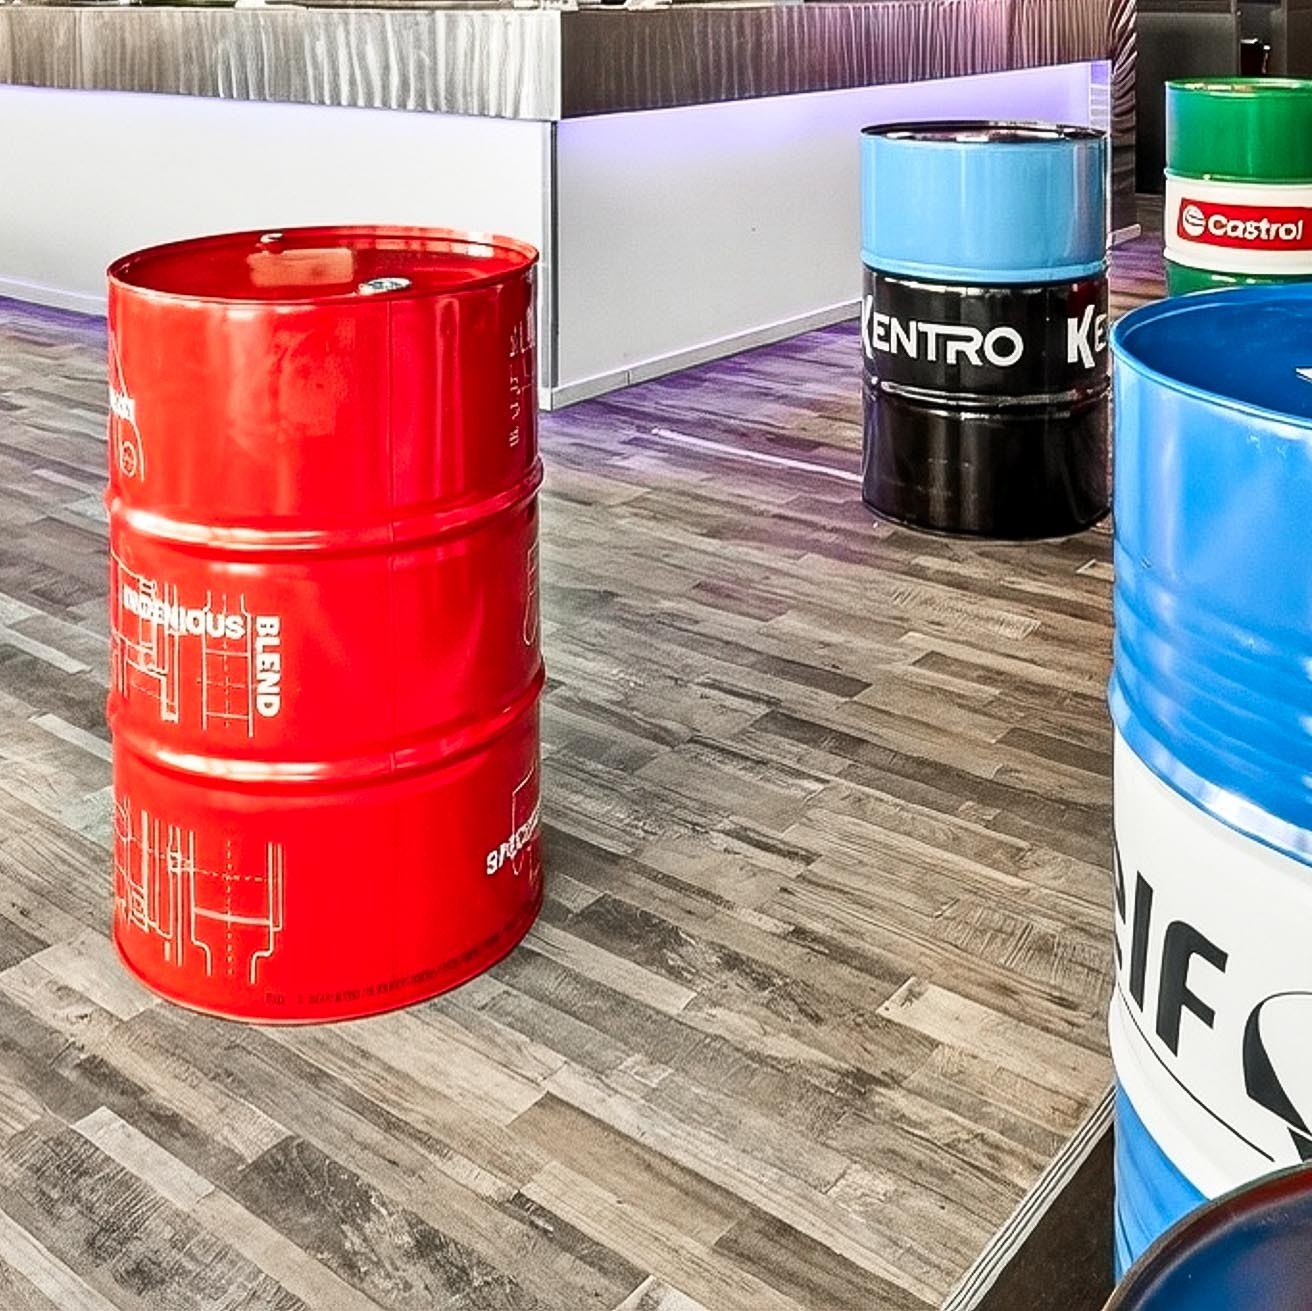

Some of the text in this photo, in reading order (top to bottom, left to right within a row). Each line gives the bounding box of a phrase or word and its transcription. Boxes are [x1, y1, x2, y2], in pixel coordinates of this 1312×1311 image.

[1207, 213, 1304, 241] Castrol
[123, 584, 246, 640] INGENIOUS
[255, 615, 281, 718] BLEND
